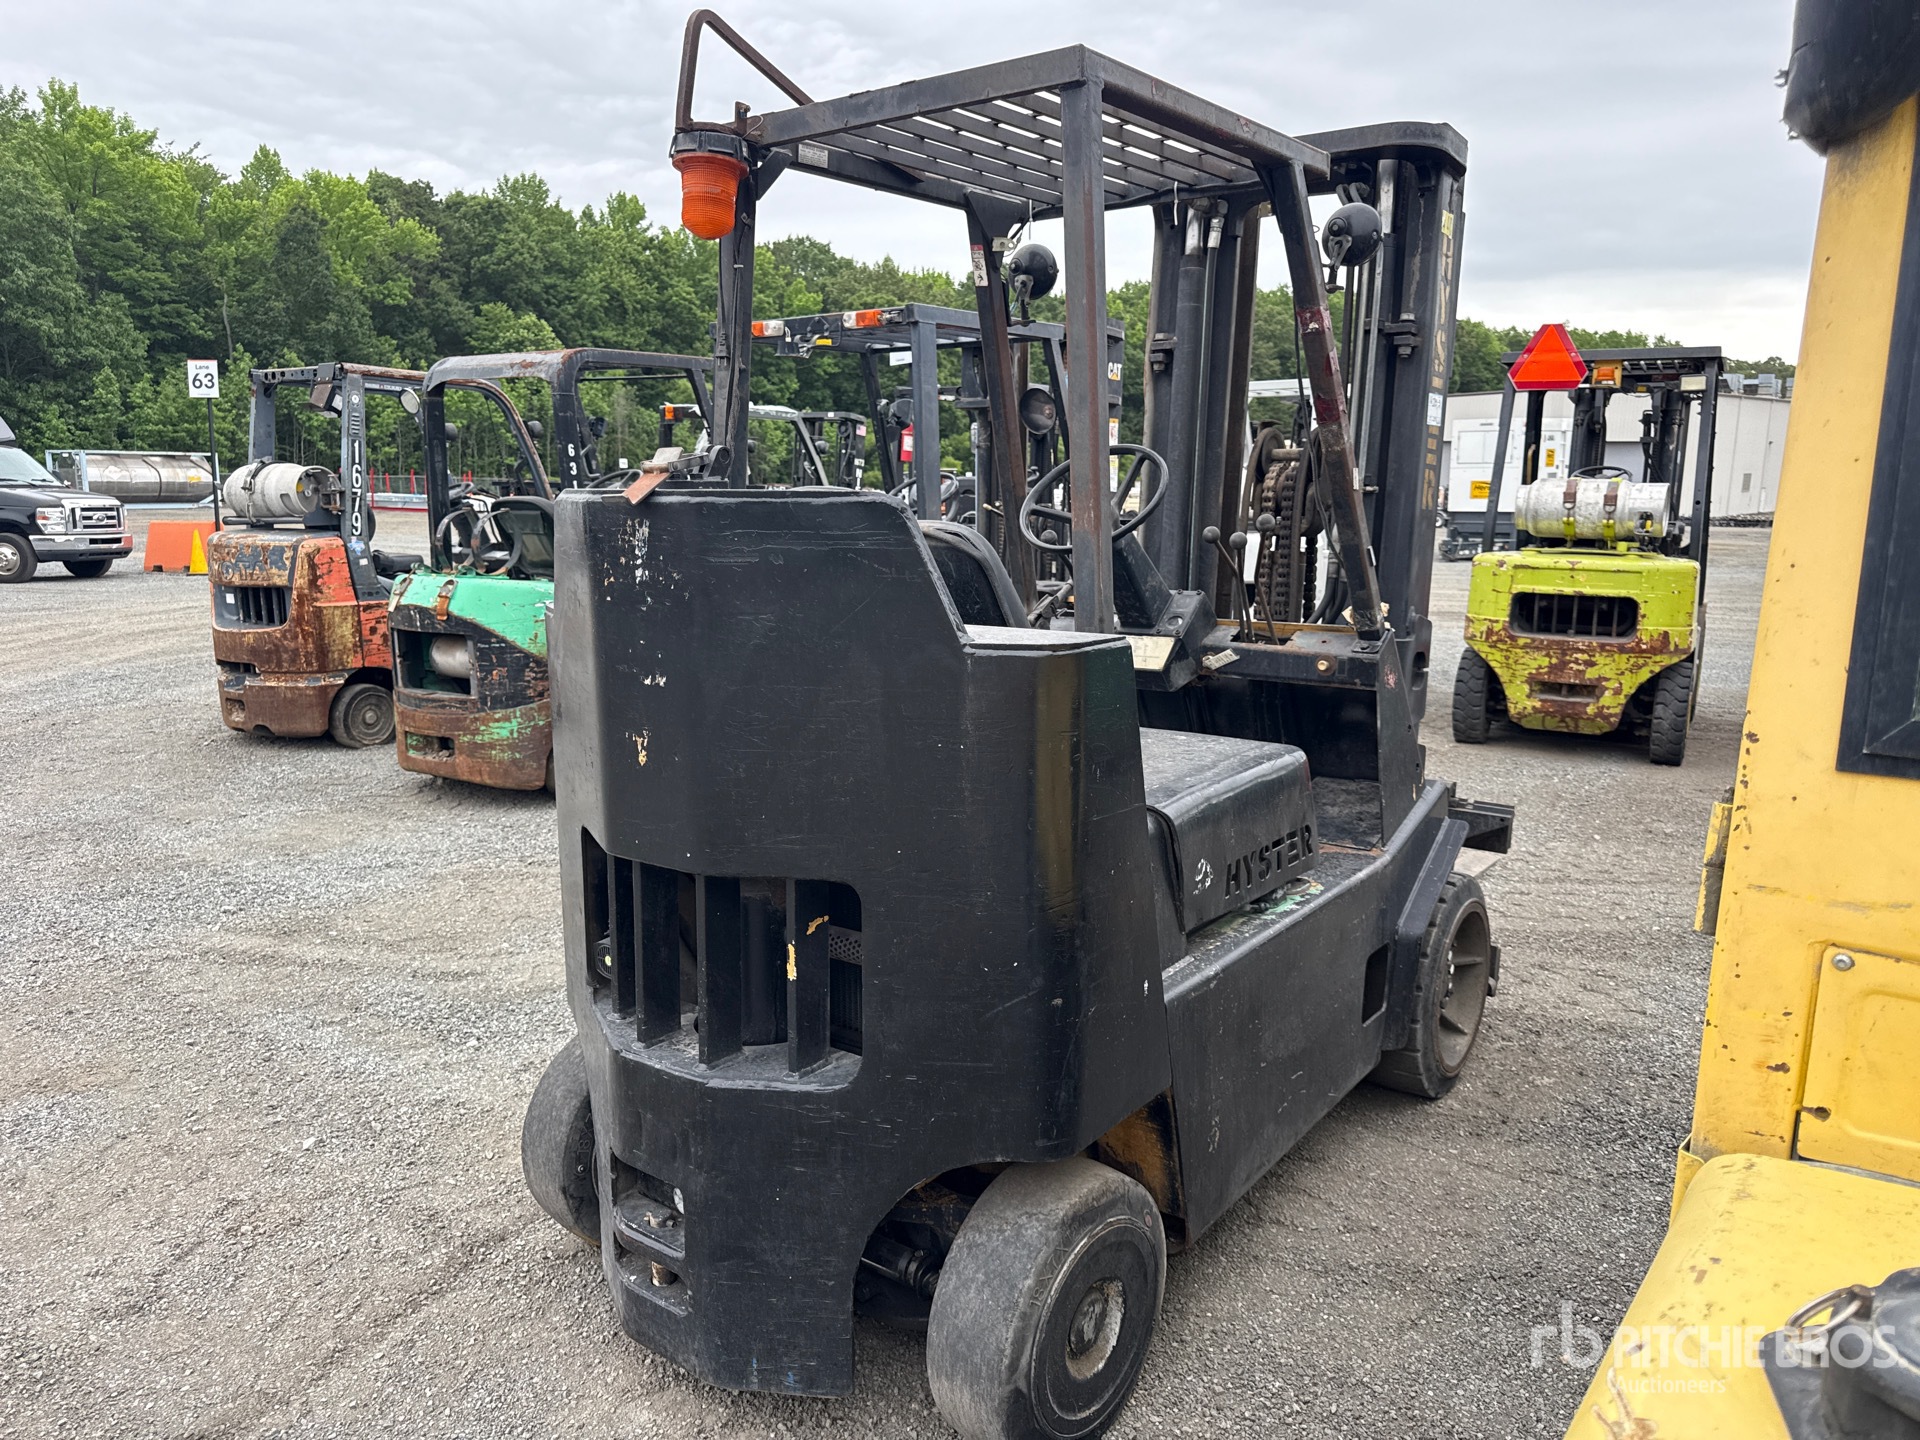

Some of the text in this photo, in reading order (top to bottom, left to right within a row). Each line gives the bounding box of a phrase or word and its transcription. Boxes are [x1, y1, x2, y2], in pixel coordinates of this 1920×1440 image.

[192, 372, 215, 389] 63
[1107, 361, 1123, 380] CAT
[351, 439, 362, 536] 1679
[1224, 824, 1314, 899] HYSTER
